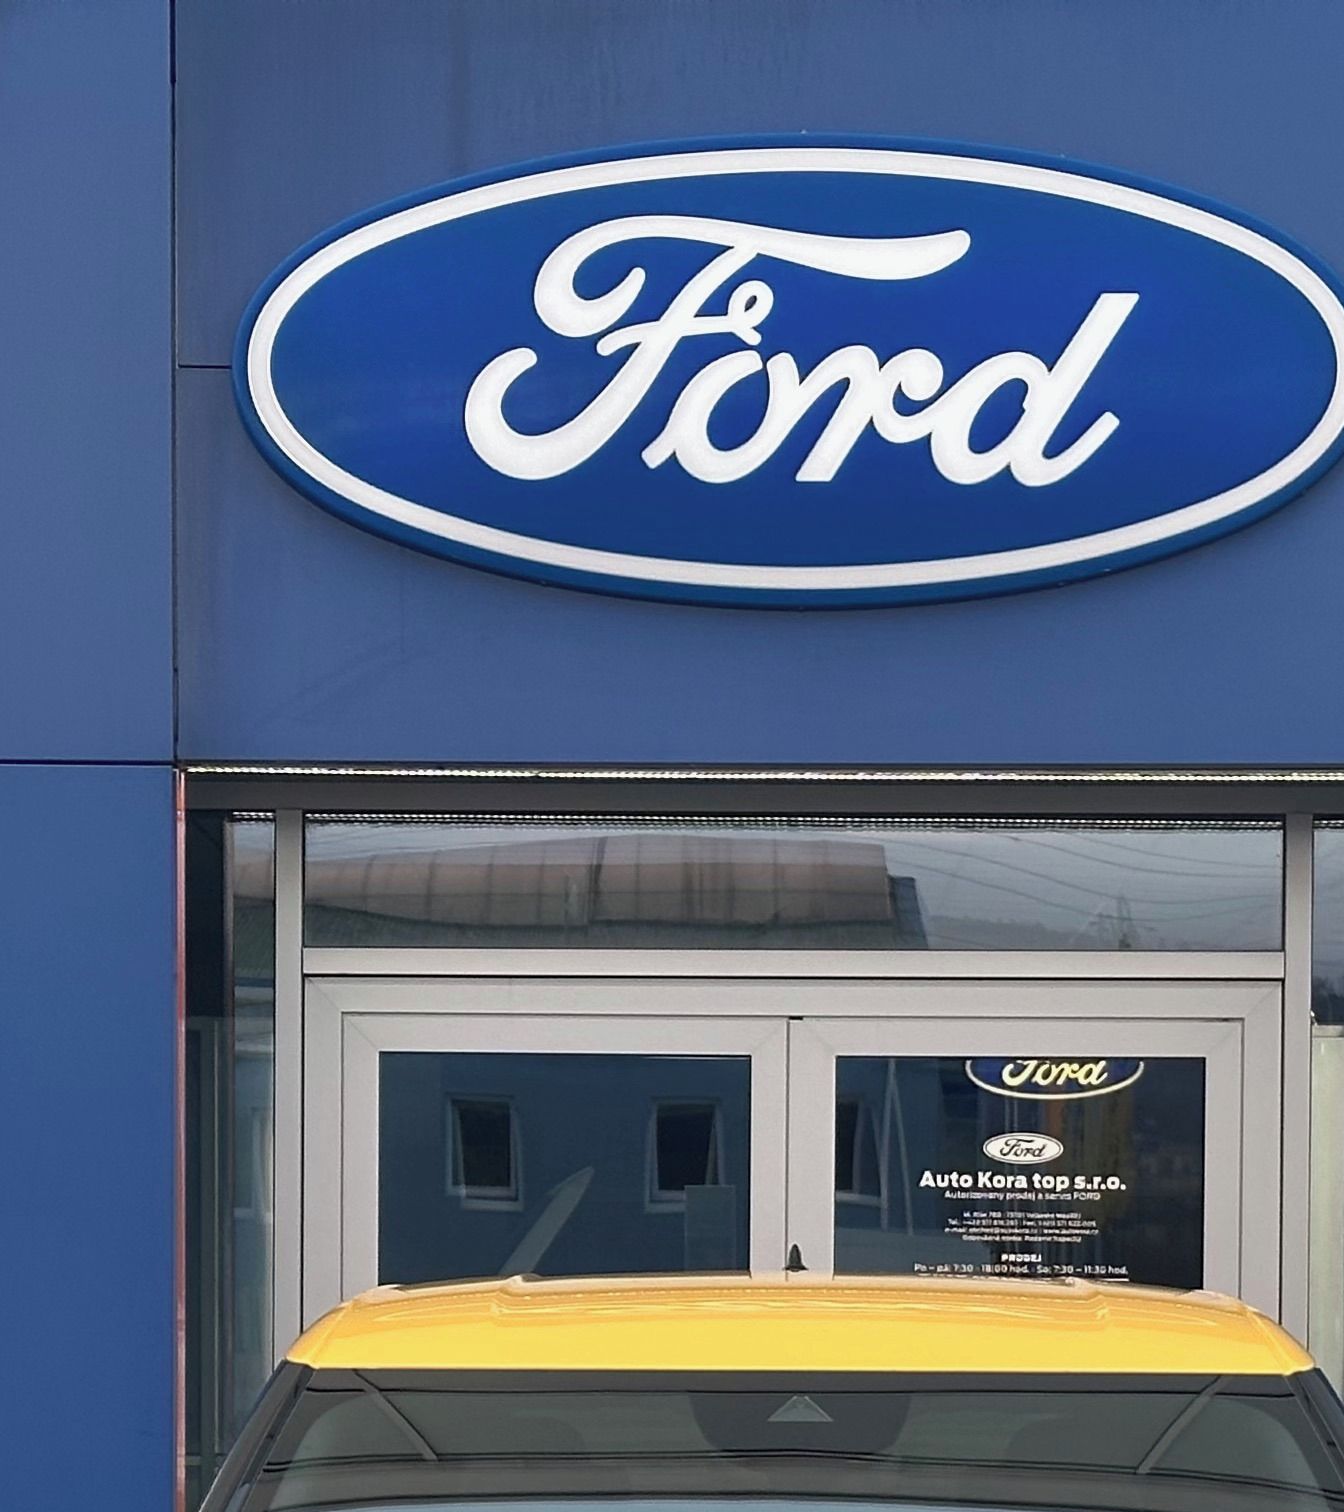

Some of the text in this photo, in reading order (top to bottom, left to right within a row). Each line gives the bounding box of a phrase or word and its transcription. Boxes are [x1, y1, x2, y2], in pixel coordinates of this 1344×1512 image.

[464, 215, 1140, 487] Ford
[999, 1138, 1047, 1158] Ford
[919, 1170, 1127, 1193] Auto Kora top s.r.o.
